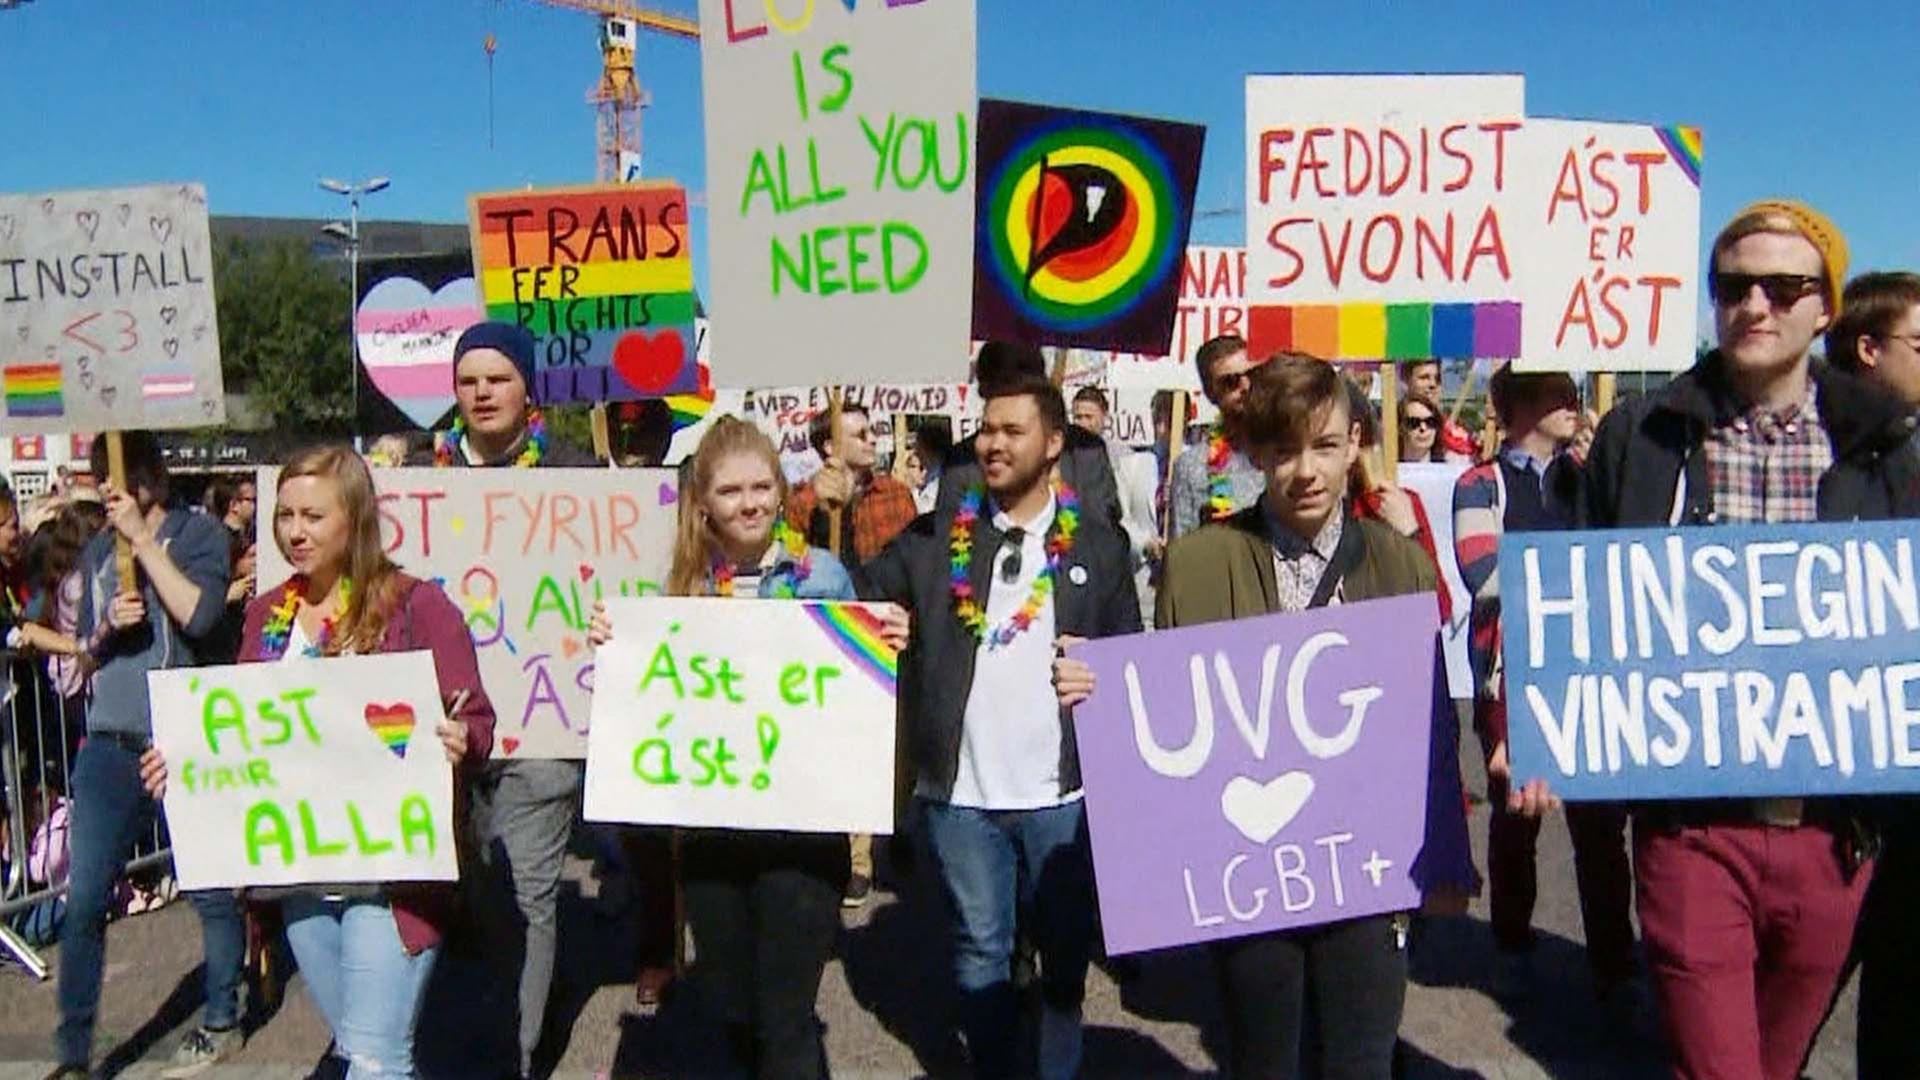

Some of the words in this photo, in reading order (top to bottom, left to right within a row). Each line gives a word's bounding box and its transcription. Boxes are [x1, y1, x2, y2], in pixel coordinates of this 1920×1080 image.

[793, 44, 853, 121] IS
[740, 135, 847, 216] ALL
[858, 111, 968, 193] YOU
[1258, 122, 1523, 205] FÆDDIST
[486, 202, 681, 268] TRANS
[770, 219, 930, 297] NEED
[1266, 203, 1512, 291] SVONA
[1589, 226, 1636, 262] ER
[0, 246, 204, 303] INSTALL
[1555, 267, 1682, 352] ÁST
[533, 329, 593, 368] OR
[377, 491, 446, 557] ST
[481, 492, 641, 560] FYRIR
[1523, 535, 1920, 668] HINSEGIN
[778, 661, 842, 707] er
[1124, 631, 1384, 778] UVG
[245, 793, 436, 866] ALLA
[1183, 832, 1394, 928] LGBT+
